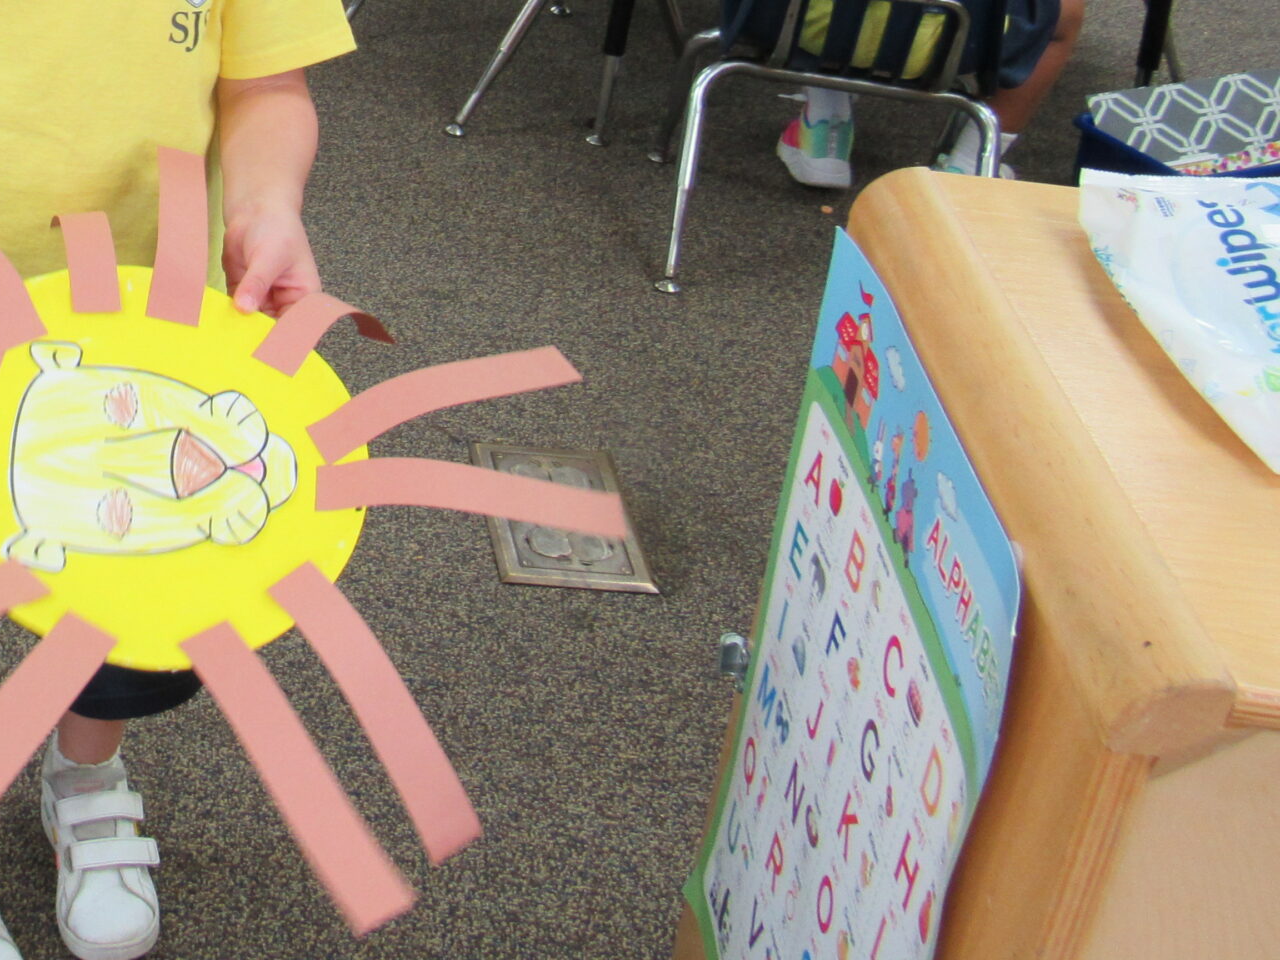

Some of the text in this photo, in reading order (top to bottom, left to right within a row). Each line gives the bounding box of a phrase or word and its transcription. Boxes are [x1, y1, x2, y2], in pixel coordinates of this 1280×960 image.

[169, 8, 210, 52] SJ
[804, 451, 823, 509] A
[844, 529, 865, 593] B
[883, 635, 904, 698] C
[920, 744, 942, 817] D
[789, 520, 809, 581] E
[826, 610, 847, 657] F
[861, 719, 880, 783] G
[894, 830, 919, 913] H
[806, 700, 825, 739] J
[836, 791, 859, 862] K
[727, 801, 764, 949] U V
[744, 737, 784, 892] Q R
[756, 664, 834, 934] M N O
